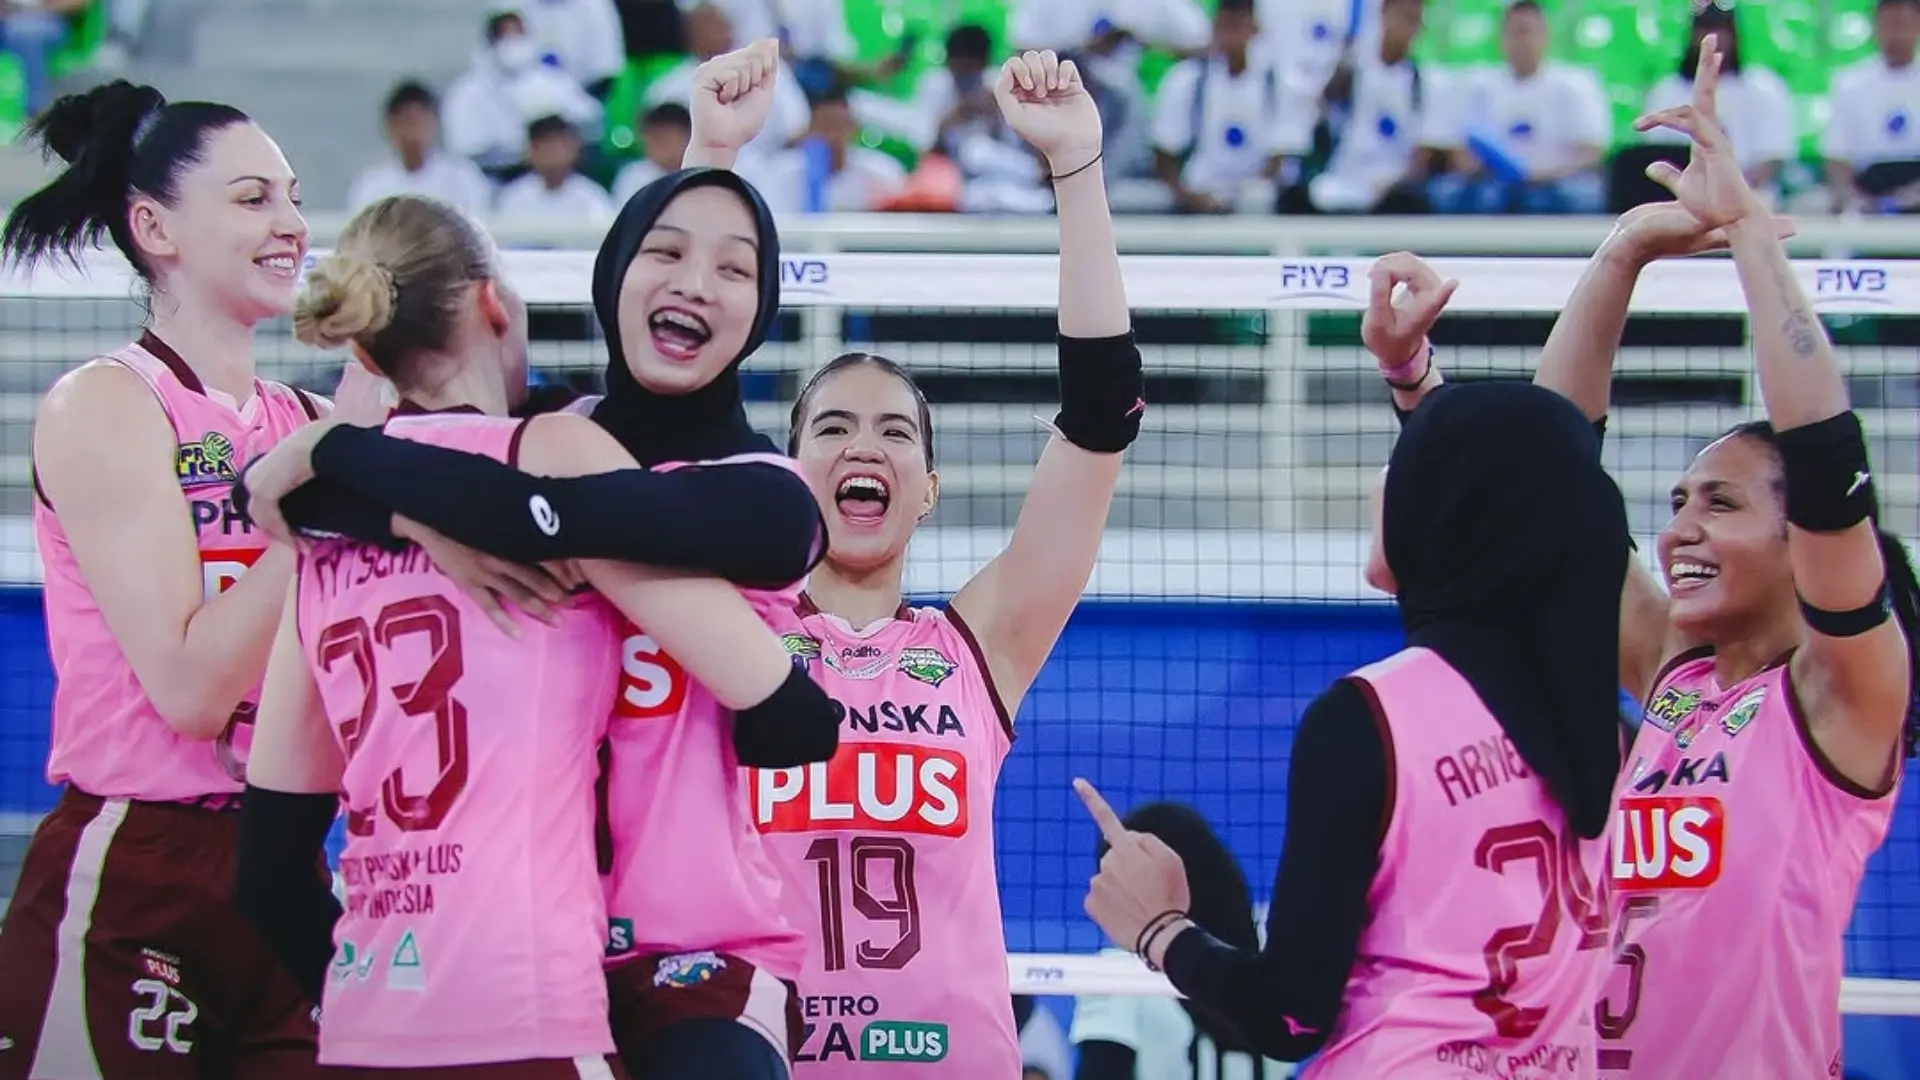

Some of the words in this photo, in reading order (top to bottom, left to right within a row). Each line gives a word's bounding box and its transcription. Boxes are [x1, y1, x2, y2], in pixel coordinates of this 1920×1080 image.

[780, 261, 828, 283] IVB
[1282, 266, 1349, 288] FIVB
[1816, 269, 1886, 291] FIVB
[317, 594, 468, 836] 23
[839, 700, 966, 737] NSKA
[758, 753, 959, 826] PLUS
[804, 836, 921, 971] 19
[1472, 819, 1609, 1038] 24
[130, 979, 198, 1053] 22
[800, 996, 879, 1017] ETRO
[868, 1029, 944, 1056] PLUS
